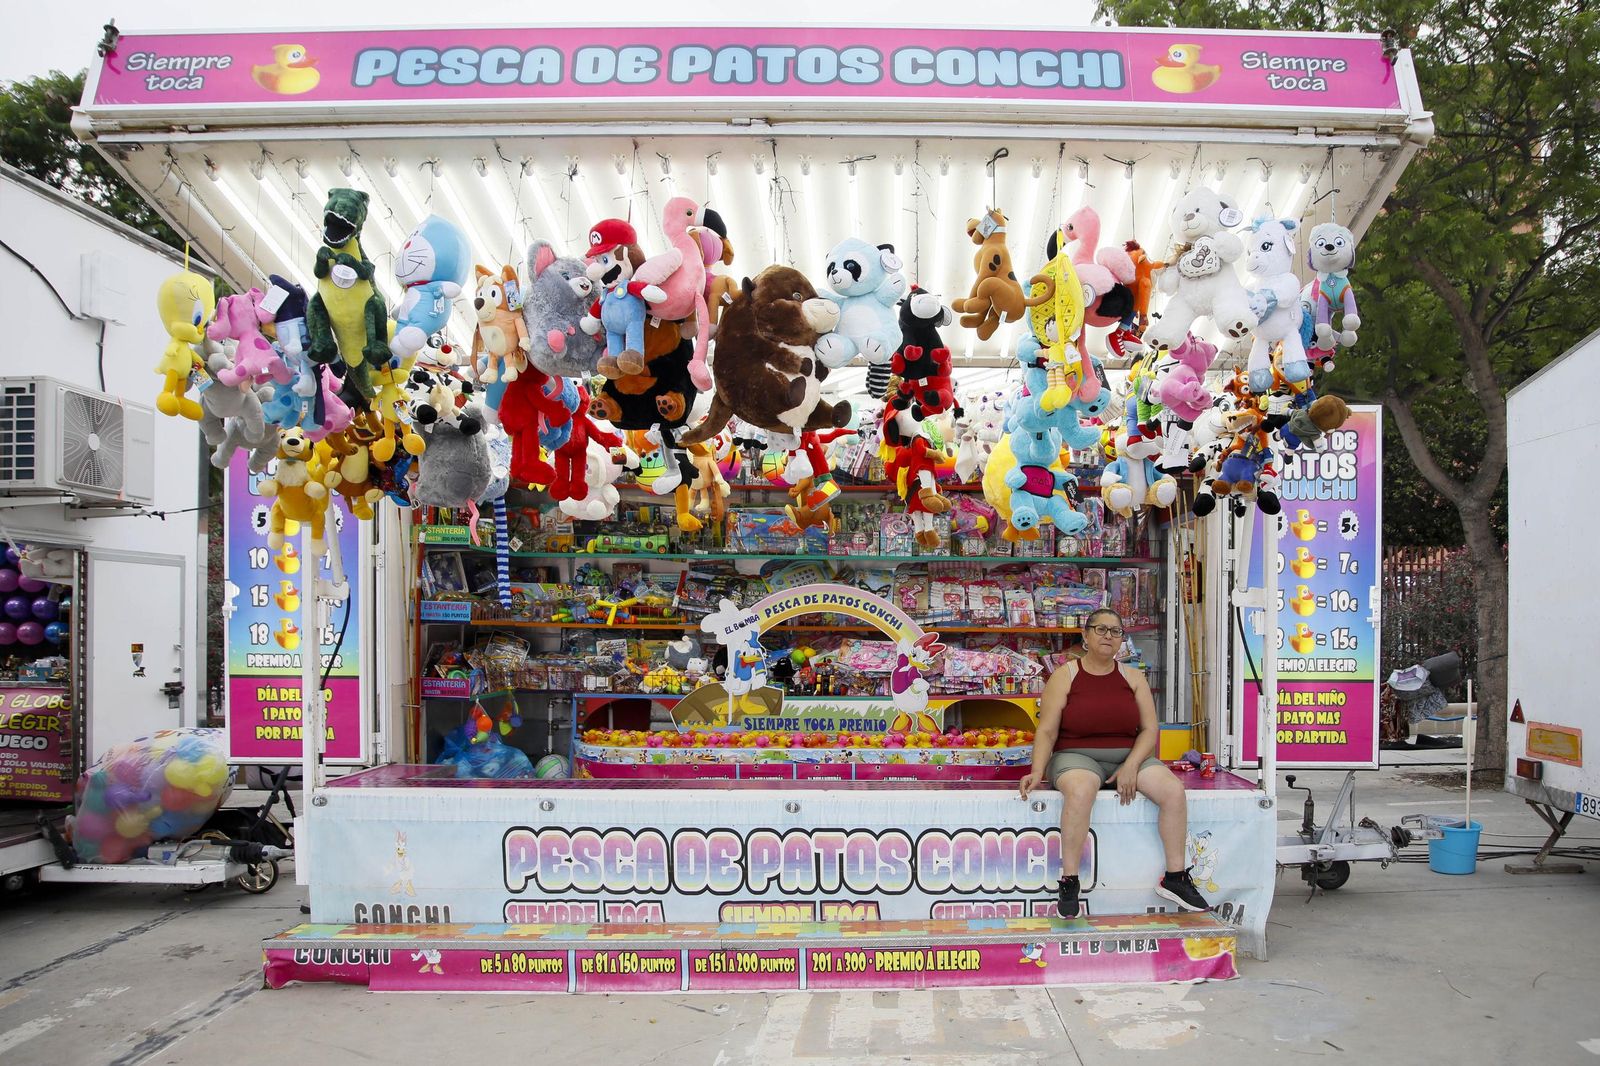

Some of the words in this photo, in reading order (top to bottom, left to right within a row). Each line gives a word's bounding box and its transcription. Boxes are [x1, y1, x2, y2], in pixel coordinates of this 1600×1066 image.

[125, 52, 232, 76] Siempre
[352, 46, 563, 88] PESCA
[573, 45, 660, 85] DE
[668, 45, 883, 85] PATOS
[891, 45, 1126, 90] CONCHI
[1241, 50, 1347, 74] Siempre
[145, 72, 204, 93] toca
[1265, 72, 1328, 92] toca
[1276, 475, 1358, 501] ONCHI
[256, 512, 267, 524] 5
[426, 526, 466, 535] STANTERÍA
[248, 547, 269, 569] 10
[250, 584, 269, 607] 15
[764, 598, 801, 619] PESCA
[803, 594, 819, 605] DE
[822, 593, 861, 608] PATOS
[862, 601, 904, 631] CONCHI
[248, 622, 270, 646] 18
[724, 626, 733, 635] EL
[247, 653, 292, 669] PREMIO
[292, 654, 302, 668] A
[1306, 658, 1317, 673] A
[1317, 658, 1358, 674] ELEGIR
[257, 684, 279, 702] DÍA
[280, 687, 302, 702] DEL
[1294, 692, 1315, 707] DEL
[1317, 688, 1346, 707] NIÑO
[0, 713, 60, 732] LEGIR
[263, 707, 269, 721] 1
[270, 707, 302, 721] PATO
[1283, 711, 1315, 726] PATO
[1316, 711, 1341, 726] MAS
[255, 726, 282, 740] POR
[744, 717, 800, 733] SIEMPRE
[803, 717, 835, 733] TOCA
[839, 717, 888, 733] PREMIO
[0, 734, 48, 750] UEGO
[1277, 730, 1293, 745] OR
[1295, 730, 1348, 745] PARTIDA
[504, 827, 671, 894] PESCA
[672, 828, 744, 895] DE
[745, 828, 915, 895] PATOS
[1059, 940, 1083, 956] EL
[480, 958, 494, 973] DE
[494, 951, 503, 973] 5
[503, 958, 511, 973] A
[512, 952, 528, 973] 80
[528, 959, 564, 974] PUNTOS
[581, 958, 595, 973] DE
[595, 952, 609, 974] 81
[609, 958, 617, 973] A
[617, 951, 639, 974] 150
[640, 958, 676, 973] PUNTOS
[694, 958, 708, 973] DE
[708, 952, 727, 973] 151
[728, 958, 736, 973] A
[736, 952, 759, 973] 200
[760, 958, 796, 973] PUNTOS
[812, 952, 832, 973] 201
[836, 958, 845, 973] A
[845, 952, 867, 973] 300
[875, 951, 923, 973] PREMIO
[926, 951, 935, 971] A
[936, 949, 981, 972] ELEGIR
